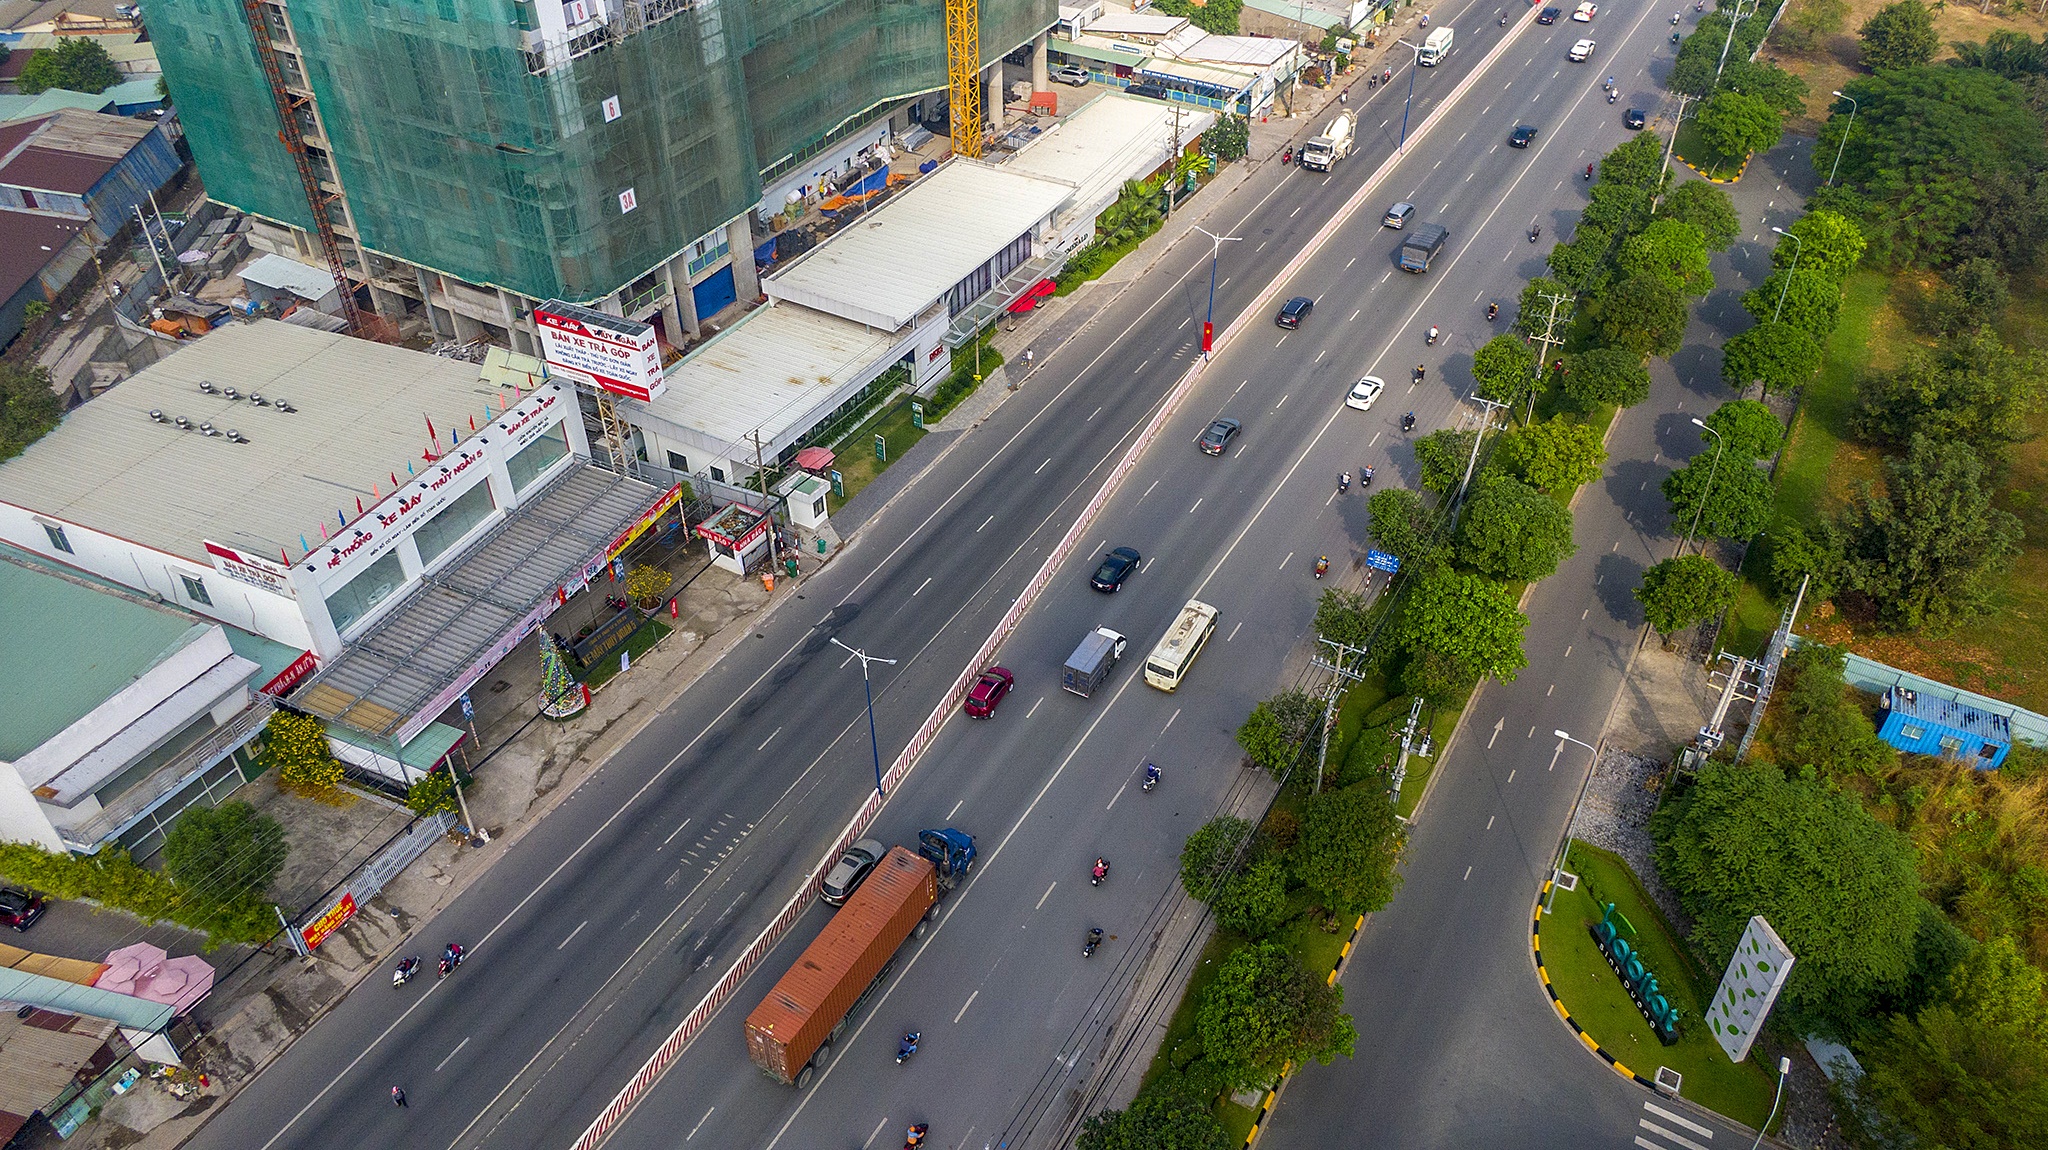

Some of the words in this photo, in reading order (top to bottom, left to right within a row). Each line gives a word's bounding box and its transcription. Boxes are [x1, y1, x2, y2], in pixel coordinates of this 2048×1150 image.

[576, 2, 584, 20] 8
[608, 102, 616, 118] 6
[622, 192, 634, 210] 3A
[551, 330, 570, 344] BÁN
[572, 337, 586, 348] XE
[588, 340, 608, 354] TRẢ
[610, 347, 630, 359] GÓP
[642, 338, 655, 352] BÁN
[647, 353, 656, 363] XE
[647, 364, 660, 377] TRẢ
[650, 377, 662, 390] GÓP
[507, 423, 521, 436] BÁN
[521, 415, 530, 425] XE
[543, 396, 556, 408] GÓP
[327, 553, 341, 569] HỆ
[341, 532, 373, 559] THỐNG
[380, 512, 398, 530] XE
[399, 493, 423, 516] MÁY
[430, 472, 453, 492] THỦY
[453, 454, 476, 476] NGÂN
[476, 449, 483, 458] 5
[314, 917, 327, 932] CHO
